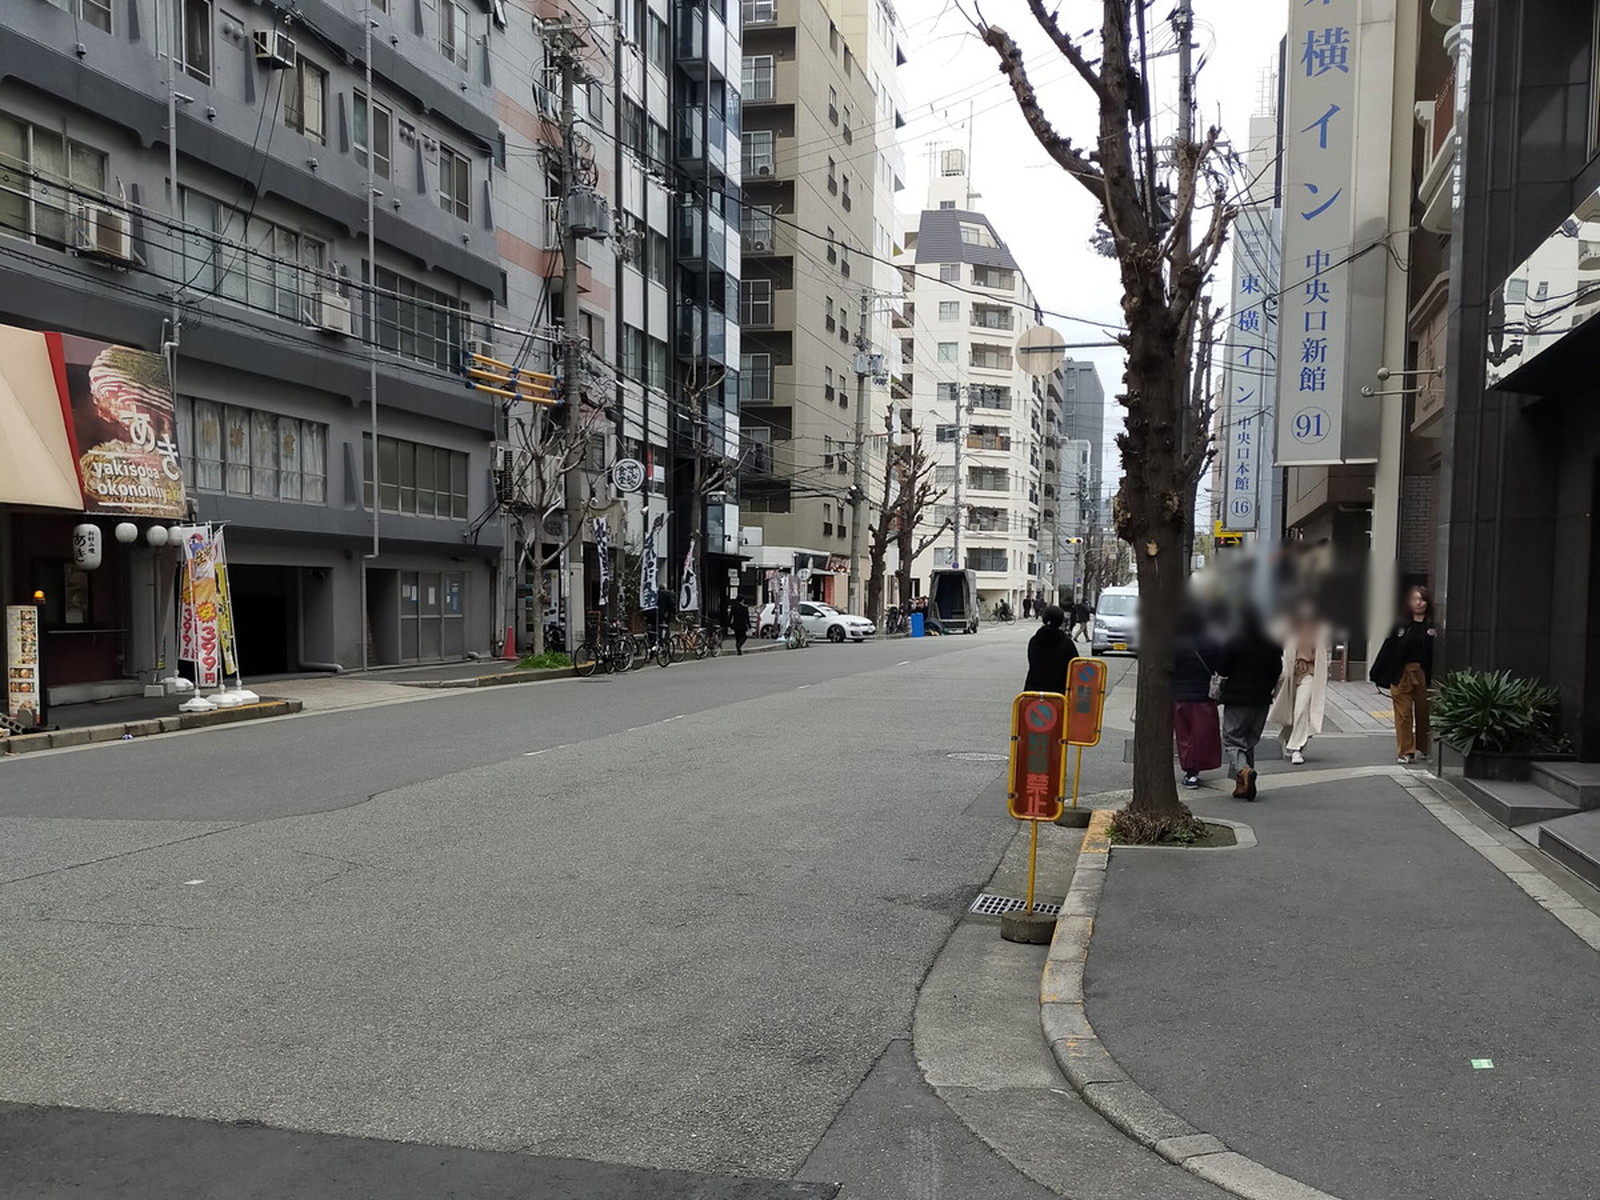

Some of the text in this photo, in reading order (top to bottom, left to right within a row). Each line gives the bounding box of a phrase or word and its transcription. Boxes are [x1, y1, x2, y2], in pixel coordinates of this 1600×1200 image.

[1299, 0, 1350, 392] 横イン 中央口新館
[1234, 273, 1260, 490] 東横イン 中央口本館
[119, 403, 181, 481] あき
[1296, 413, 1324, 438] 91
[92, 459, 160, 479] yakisoba
[1233, 501, 1249, 514] 16
[200, 626, 217, 684] 399円
